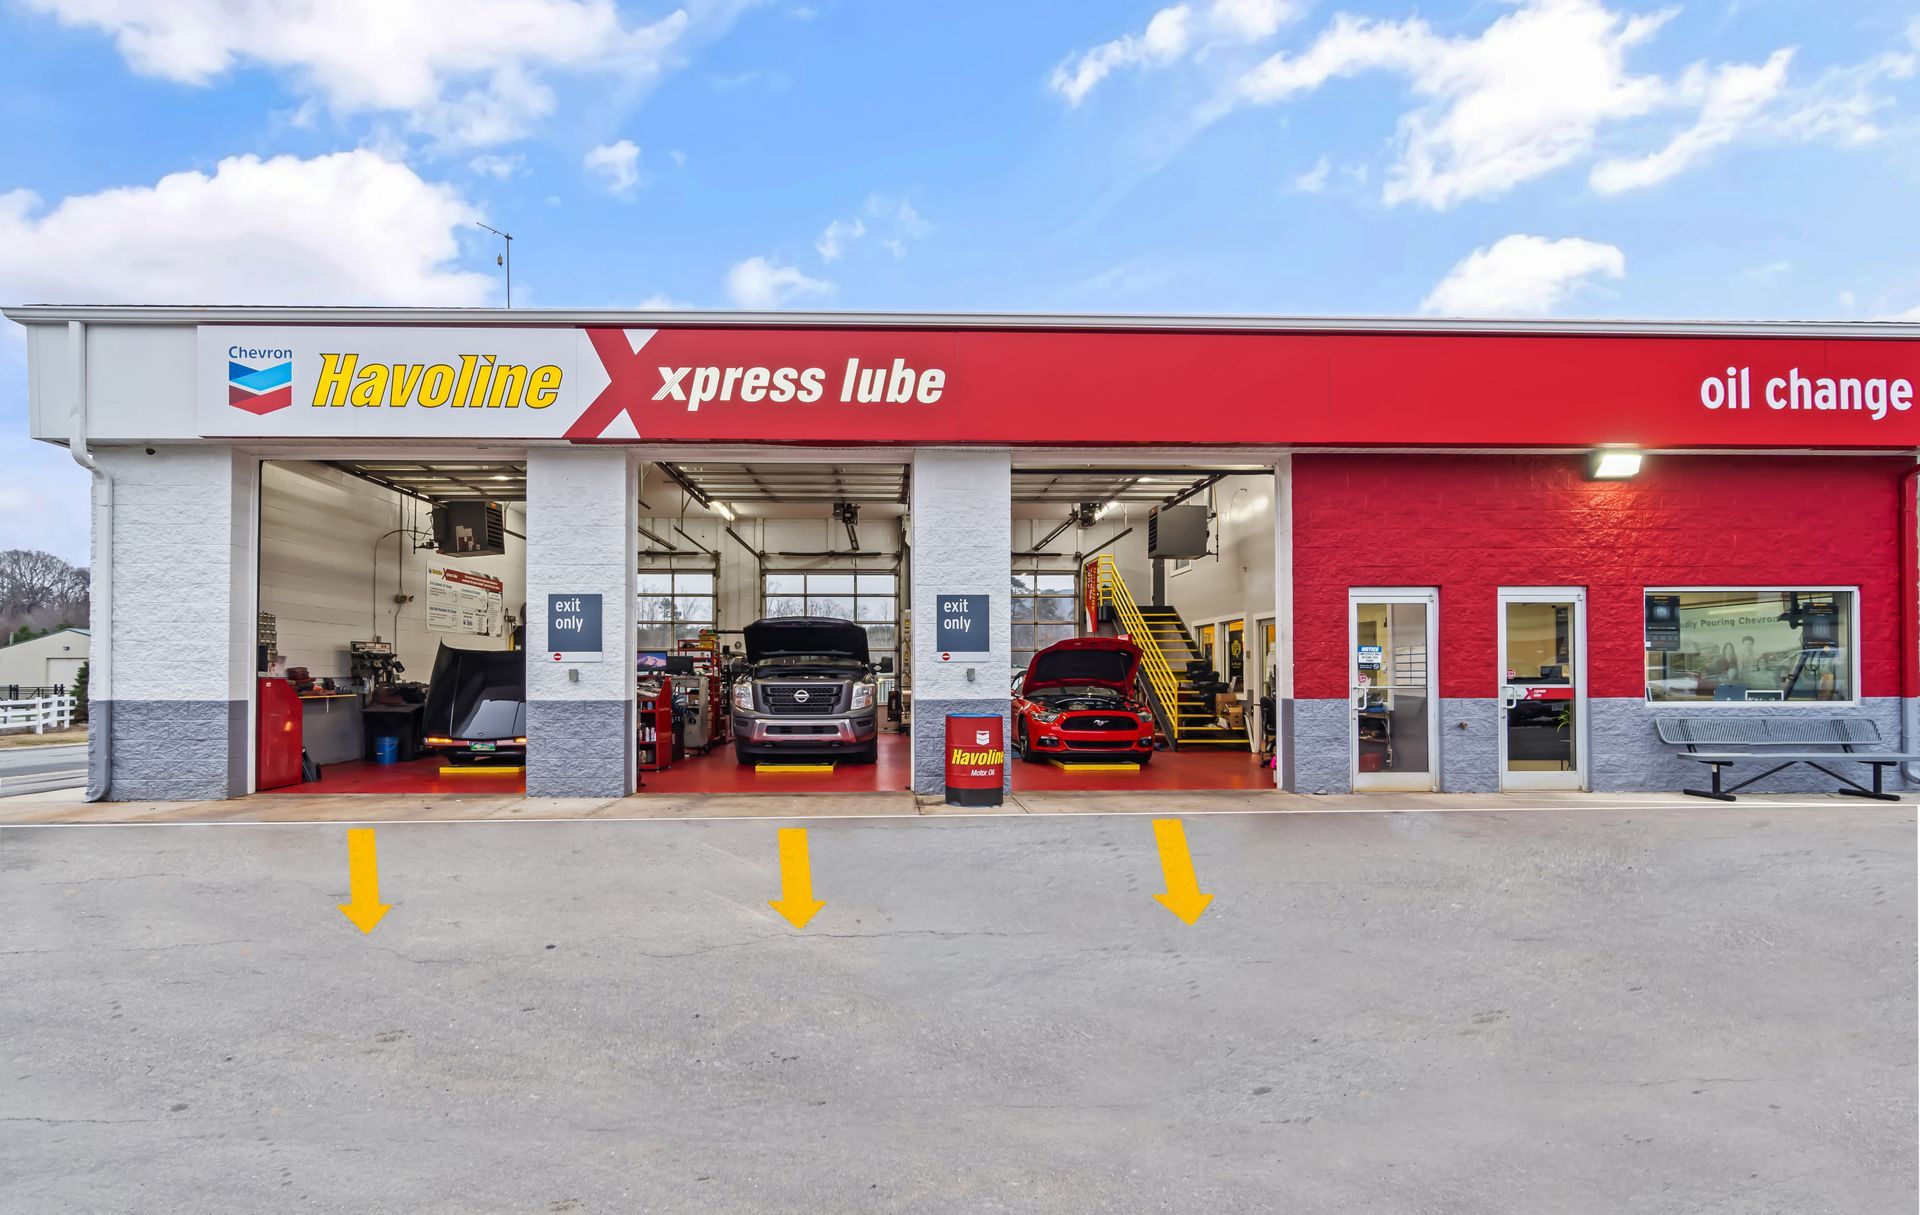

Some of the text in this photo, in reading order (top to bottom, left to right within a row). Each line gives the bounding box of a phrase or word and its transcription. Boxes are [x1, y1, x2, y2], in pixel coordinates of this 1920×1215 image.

[228, 345, 293, 359] Chevron
[311, 353, 563, 409] Havoline
[651, 366, 826, 412] xpress
[840, 358, 946, 404] lube
[1700, 366, 1914, 421] oil change
[555, 598, 581, 612] exit
[943, 598, 968, 613] exit
[555, 615, 583, 632] only
[943, 615, 971, 633] only
[1700, 617, 1736, 628] Pouring
